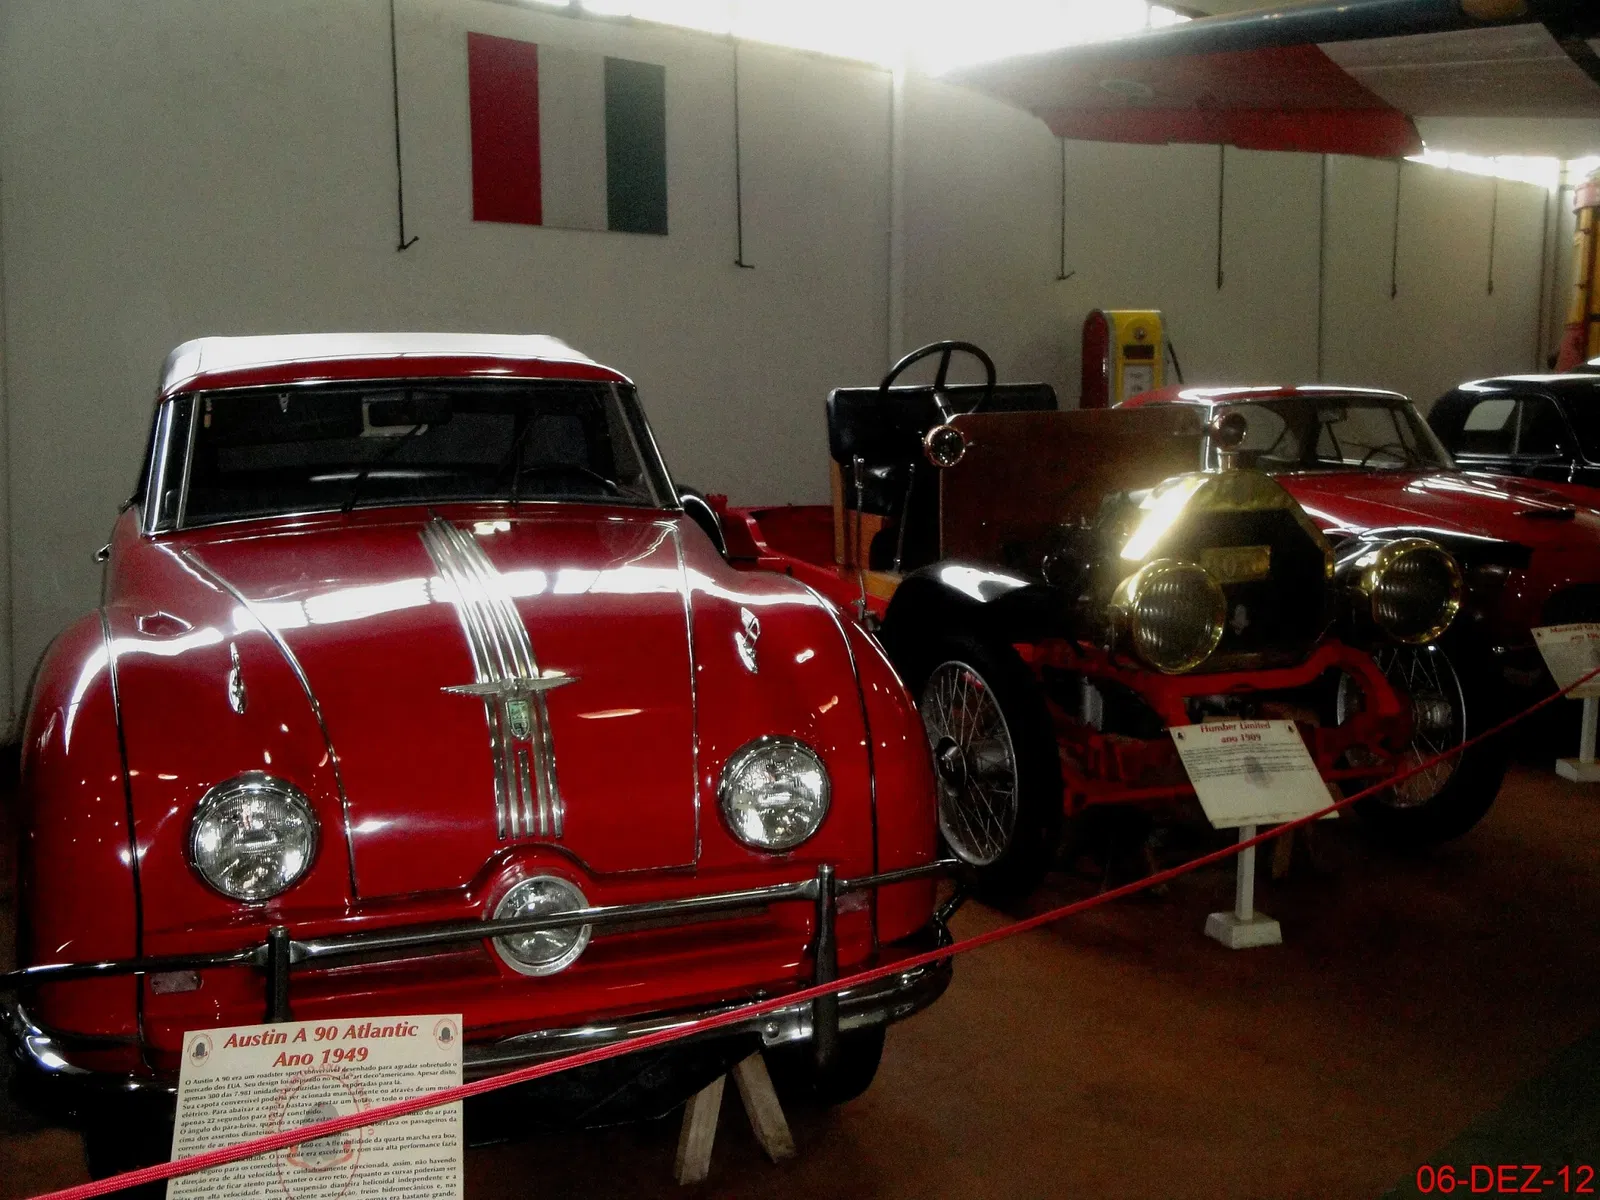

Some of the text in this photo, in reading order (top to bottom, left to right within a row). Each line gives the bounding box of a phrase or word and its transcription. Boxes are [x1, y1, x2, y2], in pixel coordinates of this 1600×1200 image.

[1201, 721, 1270, 732] Humber Limited
[223, 1028, 287, 1049] Austin
[292, 1030, 307, 1042] A
[314, 1027, 338, 1041] 90
[343, 1021, 418, 1039] Atlantic
[272, 1047, 369, 1067] Ano 1949
[285, 1086, 320, 1094] produzidas
[343, 1082, 377, 1090] exportadas
[248, 1170, 284, 1178] velocidade
[414, 1166, 445, 1174] poderiam
[223, 1189, 261, 1198] velocidade.
[398, 1175, 443, 1183] independente
